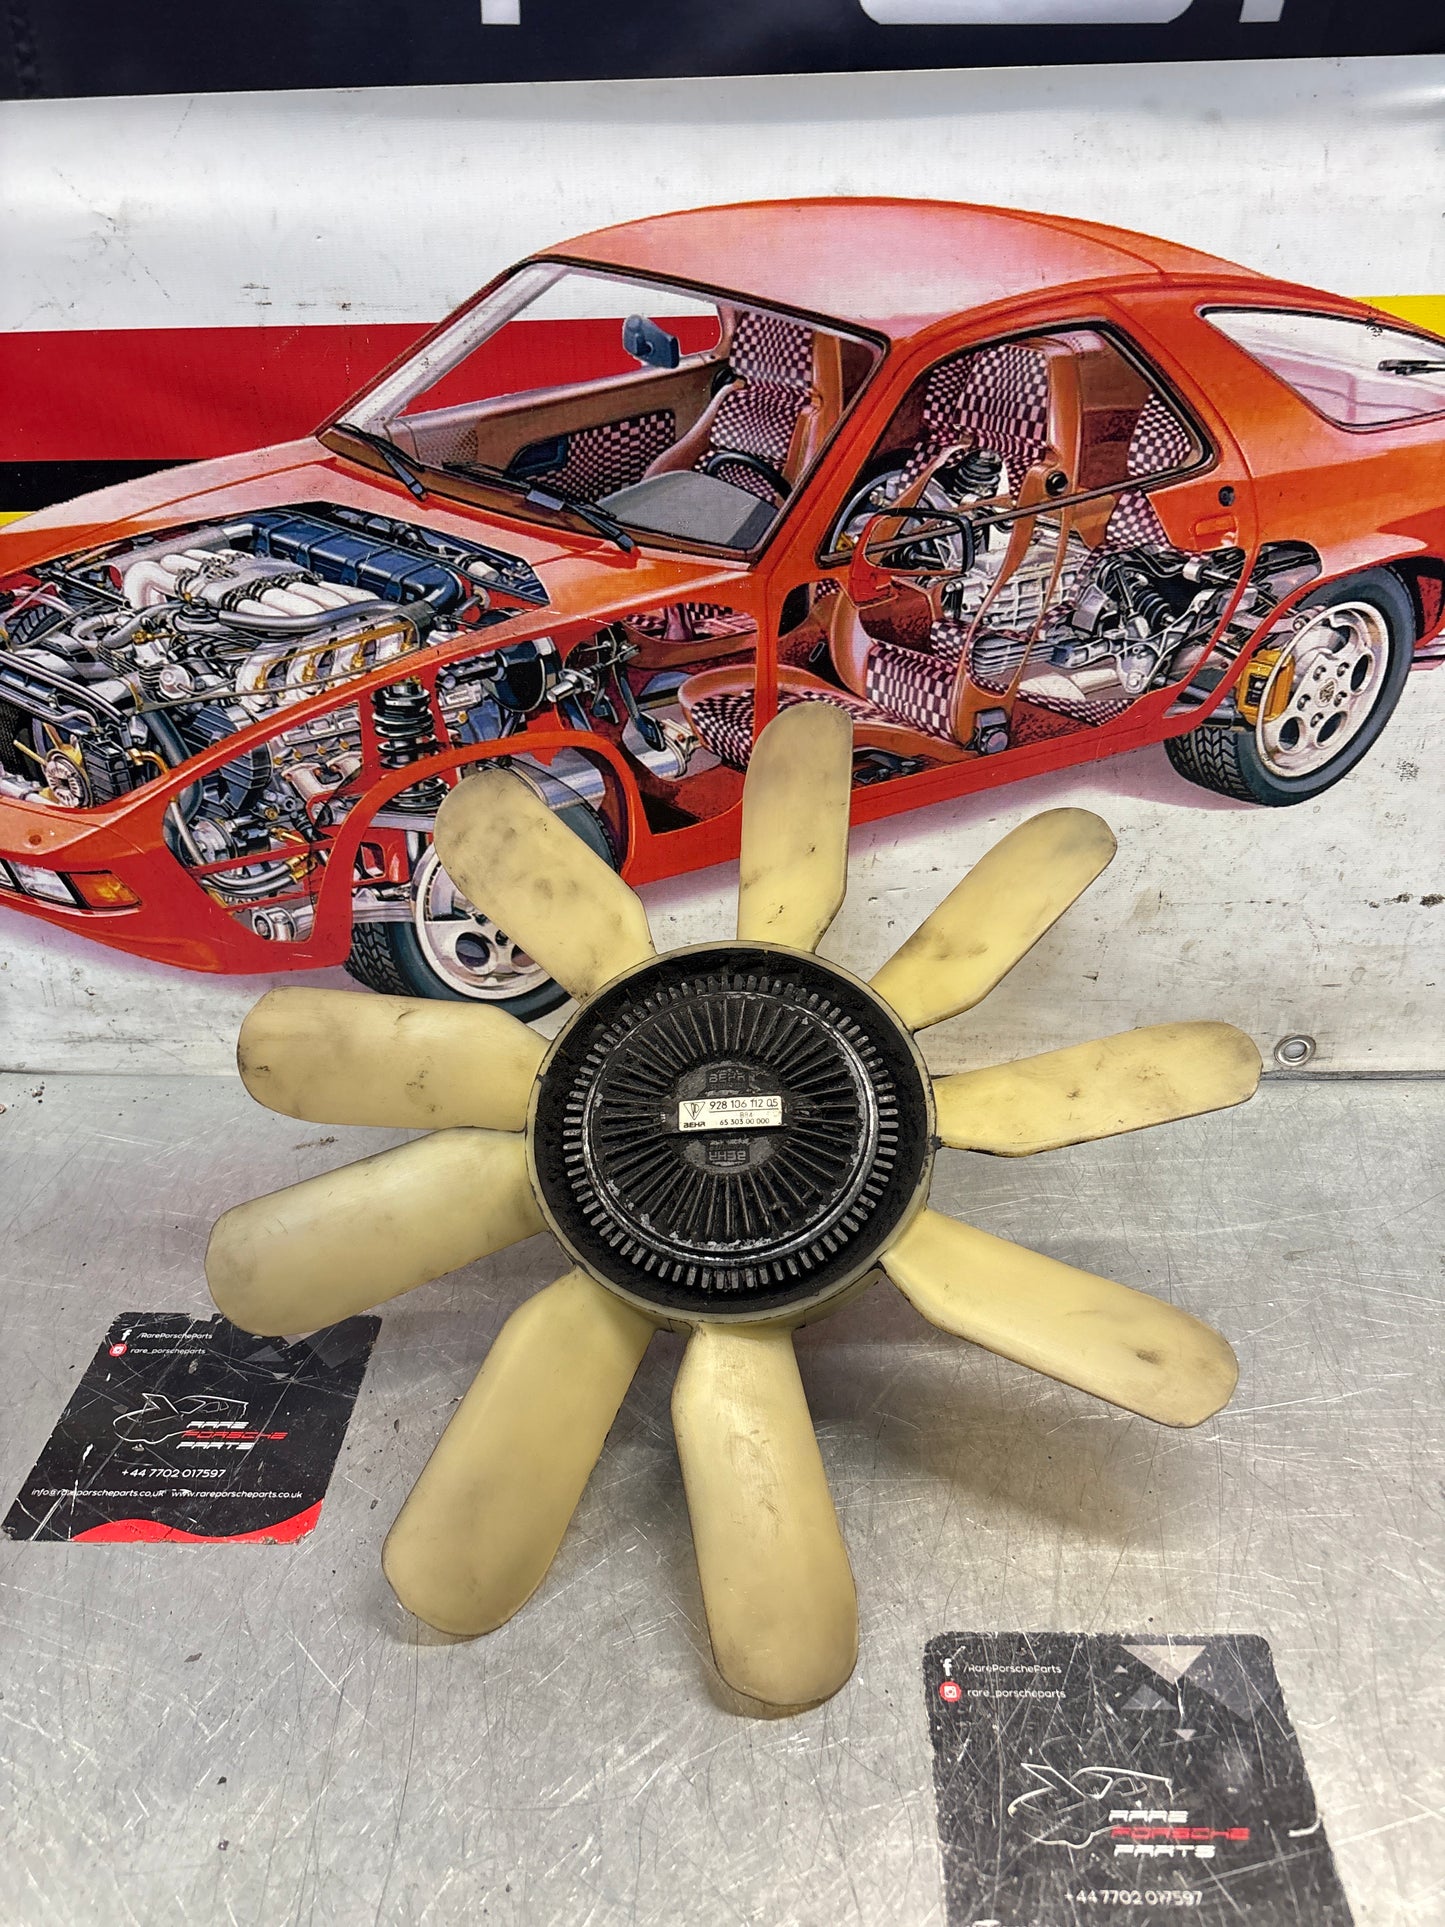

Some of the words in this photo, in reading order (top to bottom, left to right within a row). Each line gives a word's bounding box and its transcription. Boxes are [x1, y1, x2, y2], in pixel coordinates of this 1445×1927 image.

[709, 1101, 728, 1110] 928
[731, 1100, 747, 1108] 106
[750, 1099, 763, 1108] 112
[186, 1420, 249, 1429] RARE
[181, 1430, 288, 1440] PORSCHE
[175, 1441, 255, 1450] PARTS
[149, 1469, 180, 1478] 7702
[181, 1469, 226, 1478] 017597
[1108, 1810, 1188, 1823] RARE
[1111, 1826, 1250, 1840] PORSCHE
[1114, 1844, 1215, 1858] PARTS
[1098, 1889, 1143, 1905] 7702
[1144, 1889, 1203, 1906] 017597
